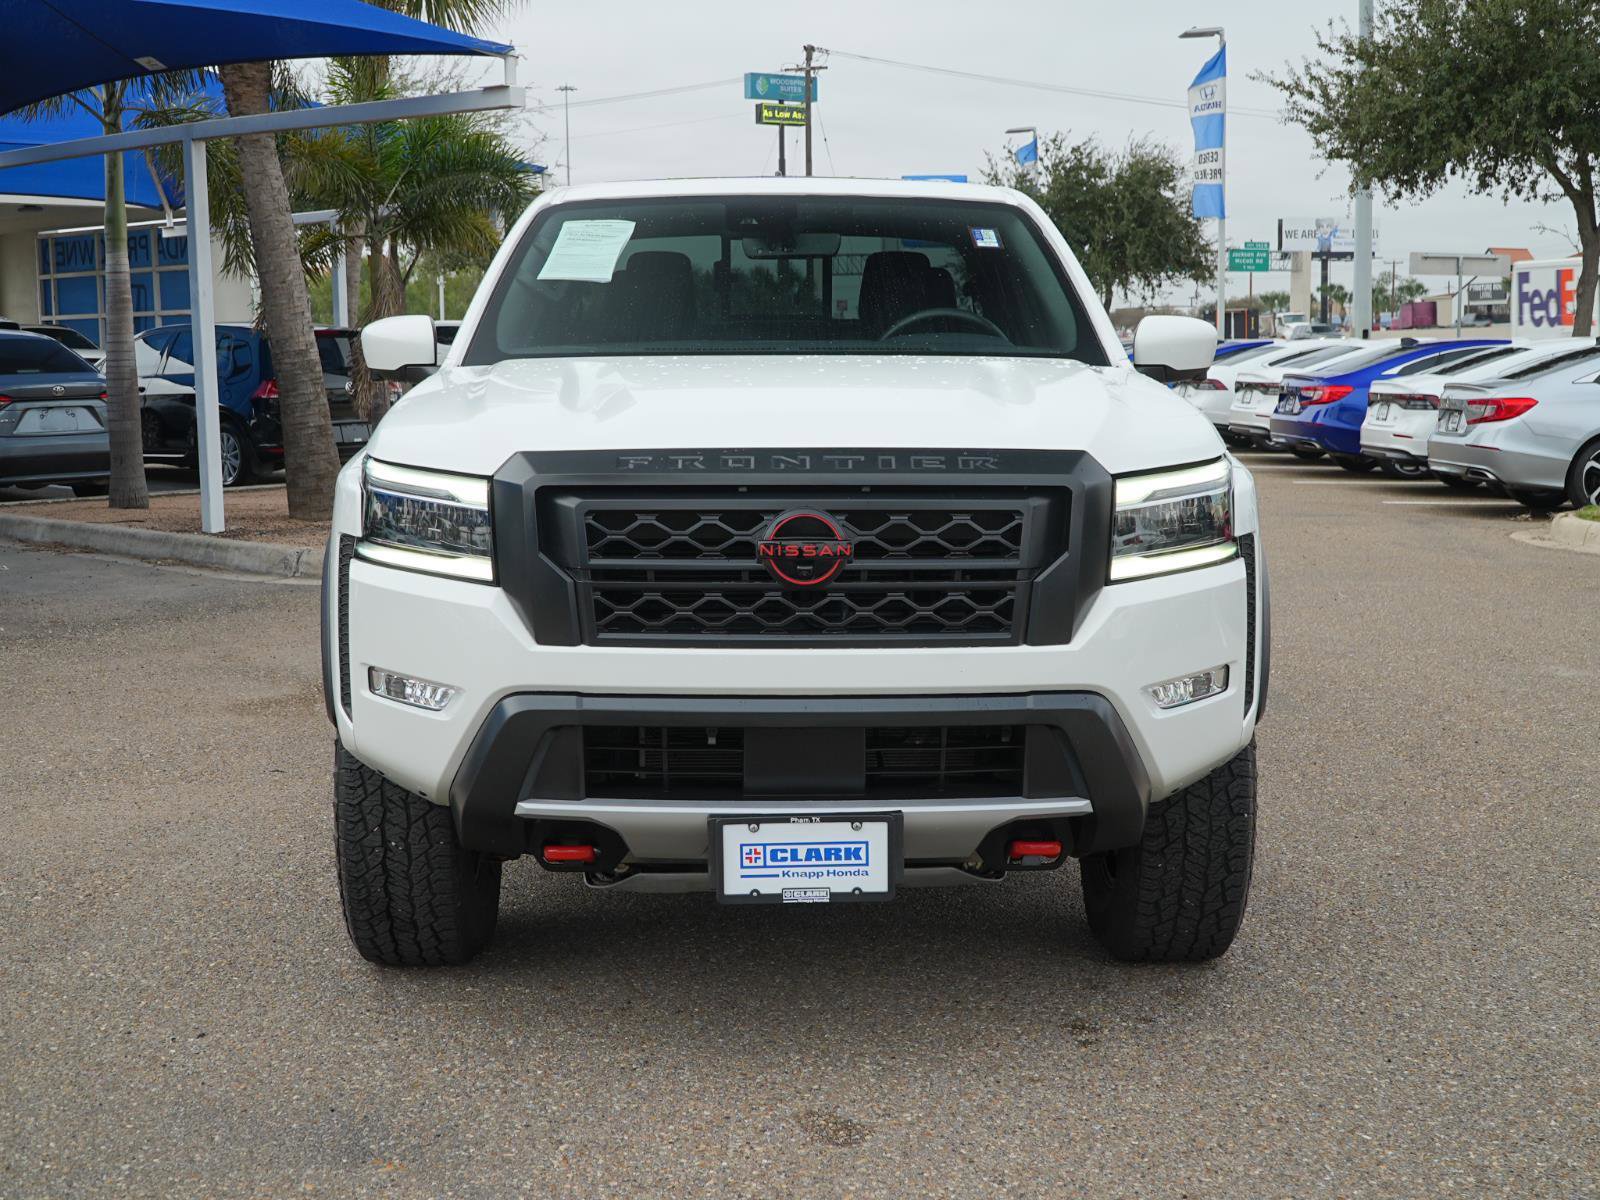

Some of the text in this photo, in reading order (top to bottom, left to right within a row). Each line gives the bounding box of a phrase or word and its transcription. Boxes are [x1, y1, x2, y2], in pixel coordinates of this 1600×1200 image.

[775, 110, 790, 118] Low
[1284, 229, 1317, 240] WE ARE
[1518, 268, 1597, 328] FedE
[616, 455, 999, 470] FRONTIER
[758, 543, 852, 557] NISSAN
[769, 846, 863, 863] CLARK
[782, 869, 869, 879] Knapp Honda
